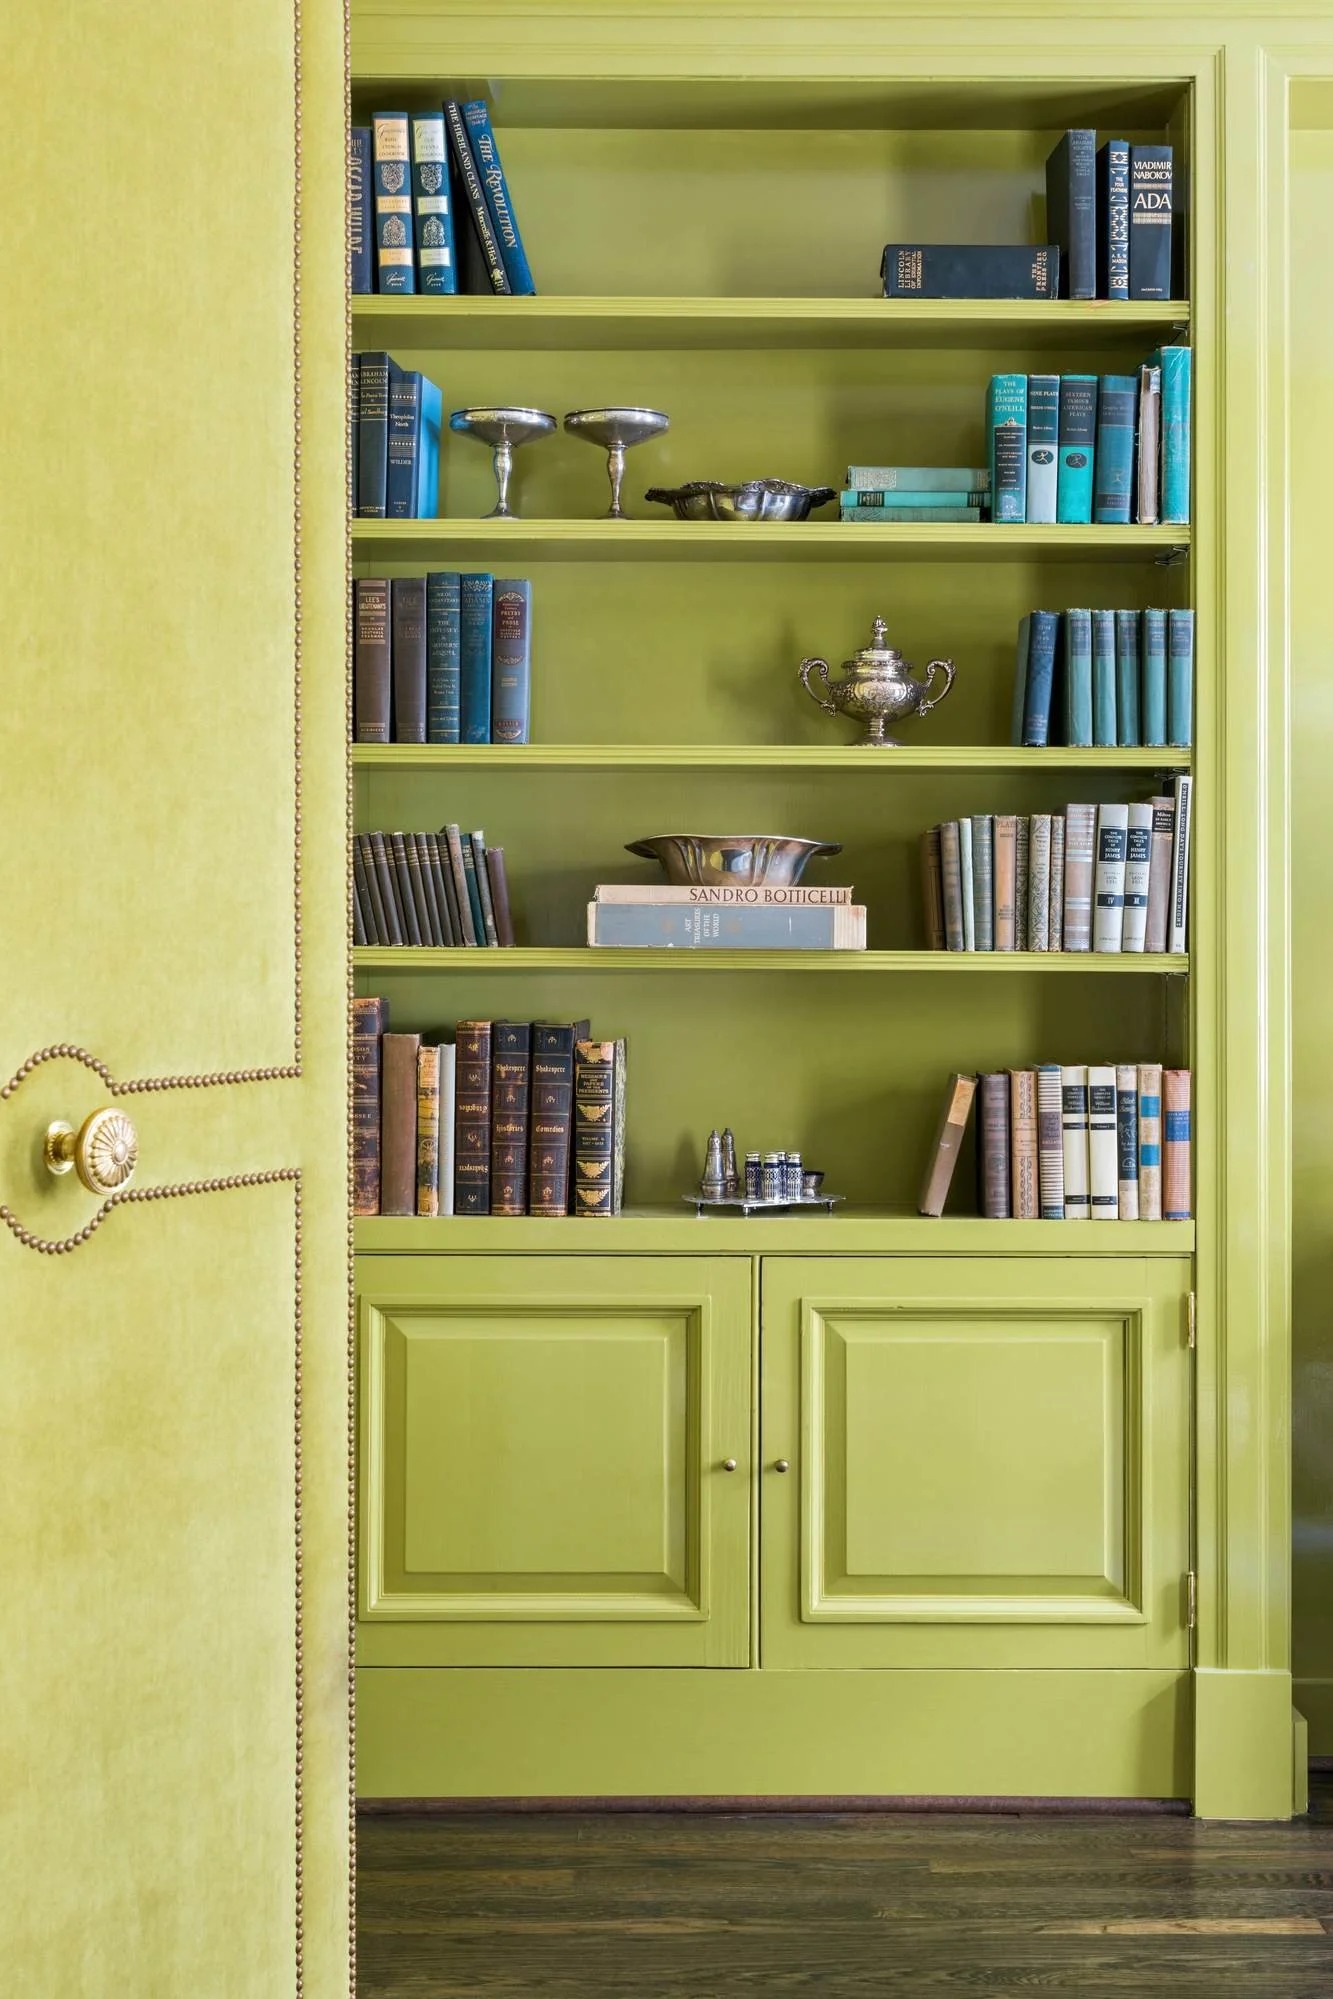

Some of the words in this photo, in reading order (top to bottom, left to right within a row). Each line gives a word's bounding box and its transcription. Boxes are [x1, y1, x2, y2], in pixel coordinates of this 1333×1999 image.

[448, 102, 459, 123] THE
[453, 123, 472, 170] HIGHLAND
[479, 134, 494, 163] THE
[1133, 161, 1172, 170] VLADIMIR
[1133, 171, 1172, 180] NABOKOV
[466, 171, 481, 199] CLANS
[486, 164, 518, 249] REVOLUTION
[1133, 193, 1172, 210] ADA
[690, 888, 758, 903] SANDRO
[764, 889, 848, 904] BOTTICELLI
[704, 927, 710, 937] OF
[536, 1124, 564, 1133] Comedies
